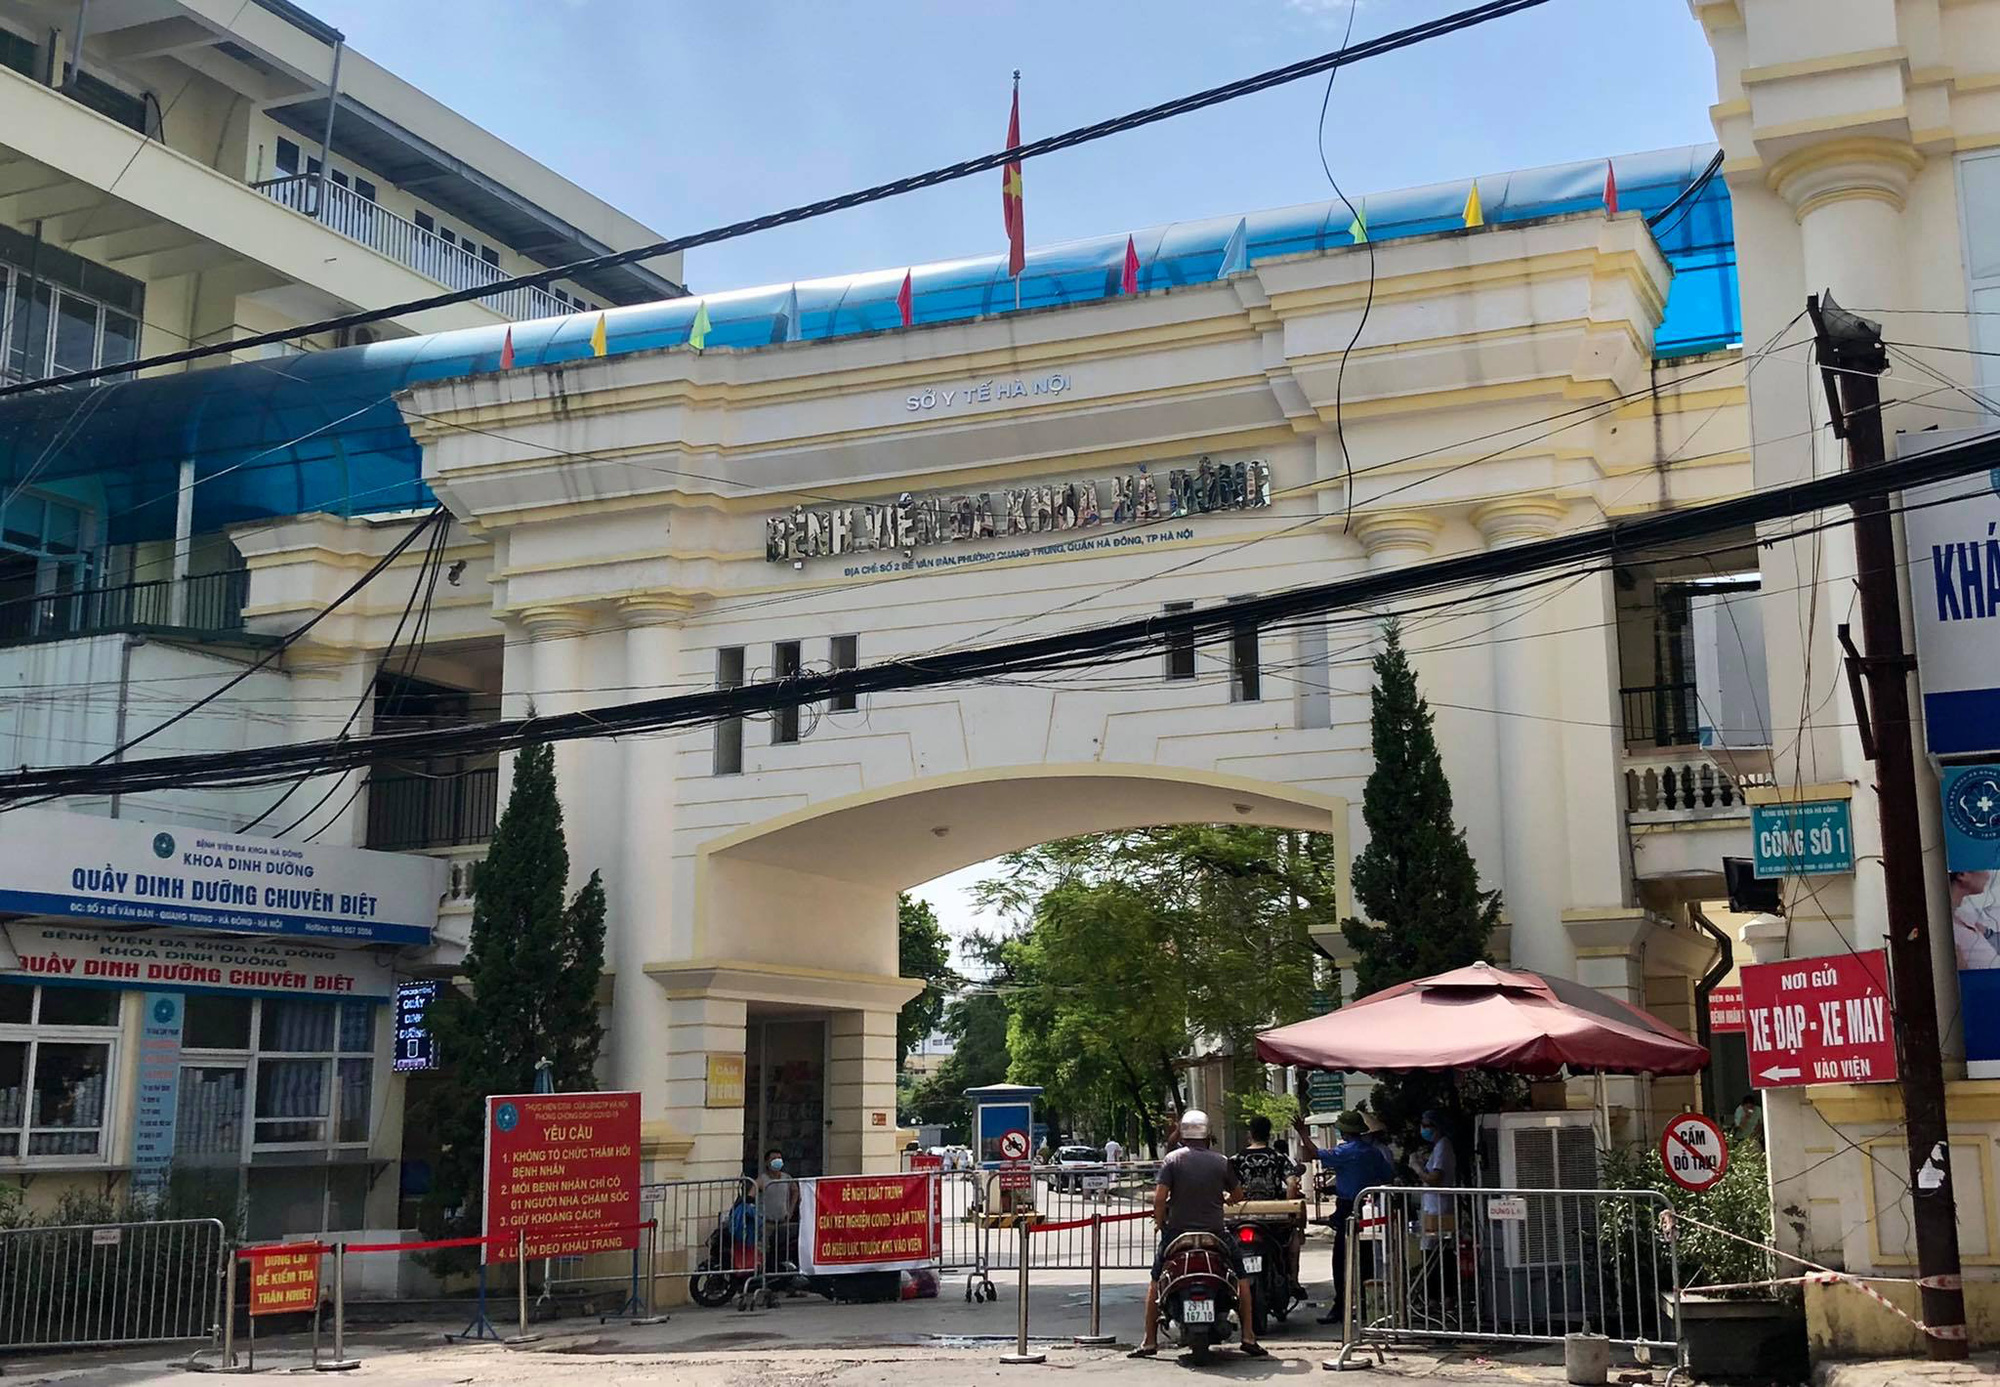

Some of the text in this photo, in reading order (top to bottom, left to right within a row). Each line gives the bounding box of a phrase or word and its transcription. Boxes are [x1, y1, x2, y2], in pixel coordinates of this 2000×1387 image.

[905, 374, 1072, 411] SỞ Y TẾ HÀ NỘI
[766, 456, 1272, 570] BỆNH VIỆN ĐA KHOA HÀ ĐÔNG
[844, 567, 860, 578] ĐỊA
[879, 561, 893, 573] SỐ
[894, 563, 900, 572] 2
[957, 551, 995, 566] PHƯỜNG
[1068, 540, 1094, 553] QUẬN
[1097, 537, 1111, 548] HÀ
[1146, 533, 1158, 542] TP
[1160, 531, 1174, 541] HÀ
[1176, 529, 1193, 541] NỘI
[1761, 817, 1845, 858] CỔNG SỐ 1
[183, 852, 314, 878] KHOA DINH DƯỠNG
[72, 863, 377, 919] QUẦY DINH DƯỠNG CHUYÊN BIỆT
[87, 901, 99, 914] SỐ
[100, 906, 106, 914] 2
[41, 930, 336, 960] BỆNH VIỆN ĐA KHOA HÀ ĐÔNG
[100, 946, 288, 968] KHOA DINH DƯỠNG
[84, 959, 140, 978] DINH
[148, 962, 222, 983] DƯỠNG
[229, 969, 306, 988] CHUYÊN
[313, 973, 355, 993] BIỆT
[1781, 963, 1837, 990] NƠI GỬI
[1750, 987, 1885, 1055] XE ĐẠP - XE MÁY
[1813, 1055, 1871, 1080] VÀO VIỆN
[543, 1123, 593, 1140] YÊU CẦU
[1680, 1125, 1706, 1145] CẤM
[503, 1153, 510, 1163] 1.
[513, 1148, 546, 1162] KHÔNG
[548, 1148, 560, 1160] TỔ
[562, 1147, 588, 1160] CHỨC
[615, 1146, 631, 1157] HỎI
[1674, 1149, 1689, 1170] ĐỖ
[512, 1162, 565, 1179] BỆNH NHÂN
[532, 1182, 559, 1194] BỆNH
[561, 1178, 587, 1190] NHÂN
[589, 1175, 605, 1188] CHỈ
[510, 1200, 521, 1210] 01
[524, 1196, 557, 1209] NGƯỜI
[559, 1195, 579, 1206] NHÀ
[610, 1191, 630, 1202] SÓC
[510, 1212, 529, 1225] GIỮ
[531, 1210, 572, 1224] KHOẢNG
[575, 1209, 601, 1220] CÁCH
[540, 1243, 560, 1254] ĐEO
[562, 1239, 585, 1251] KHẨU
[591, 1236, 622, 1249] TRANG
[256, 1268, 314, 1286] ĐỂ KIỂM TRA
[258, 1290, 283, 1303] THÂN
